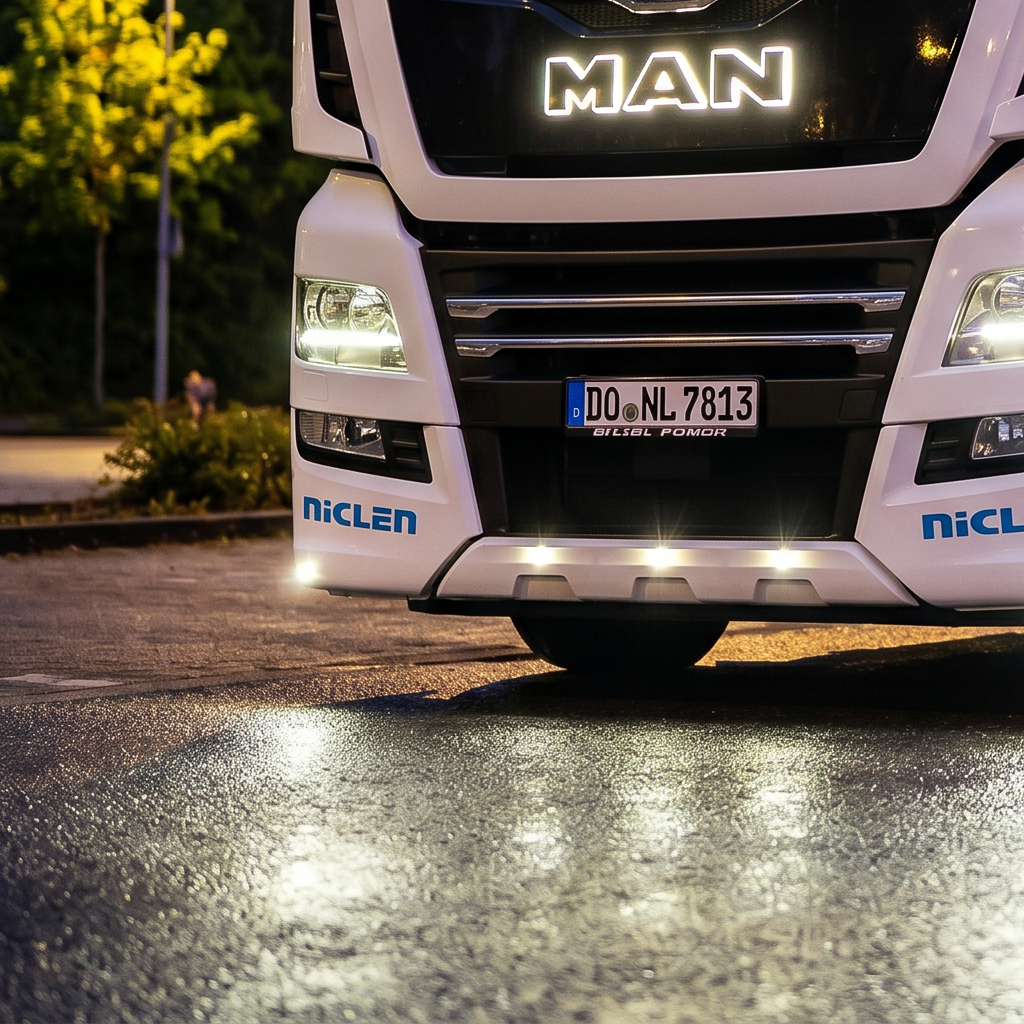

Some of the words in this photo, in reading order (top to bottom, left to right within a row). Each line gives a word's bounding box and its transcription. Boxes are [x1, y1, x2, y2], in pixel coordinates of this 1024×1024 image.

[544, 46, 793, 116] MAN
[573, 407, 580, 418] D
[586, 386, 620, 422] DO
[641, 386, 677, 422] NL
[683, 385, 753, 422] 7813
[660, 428, 727, 437] POMOR
